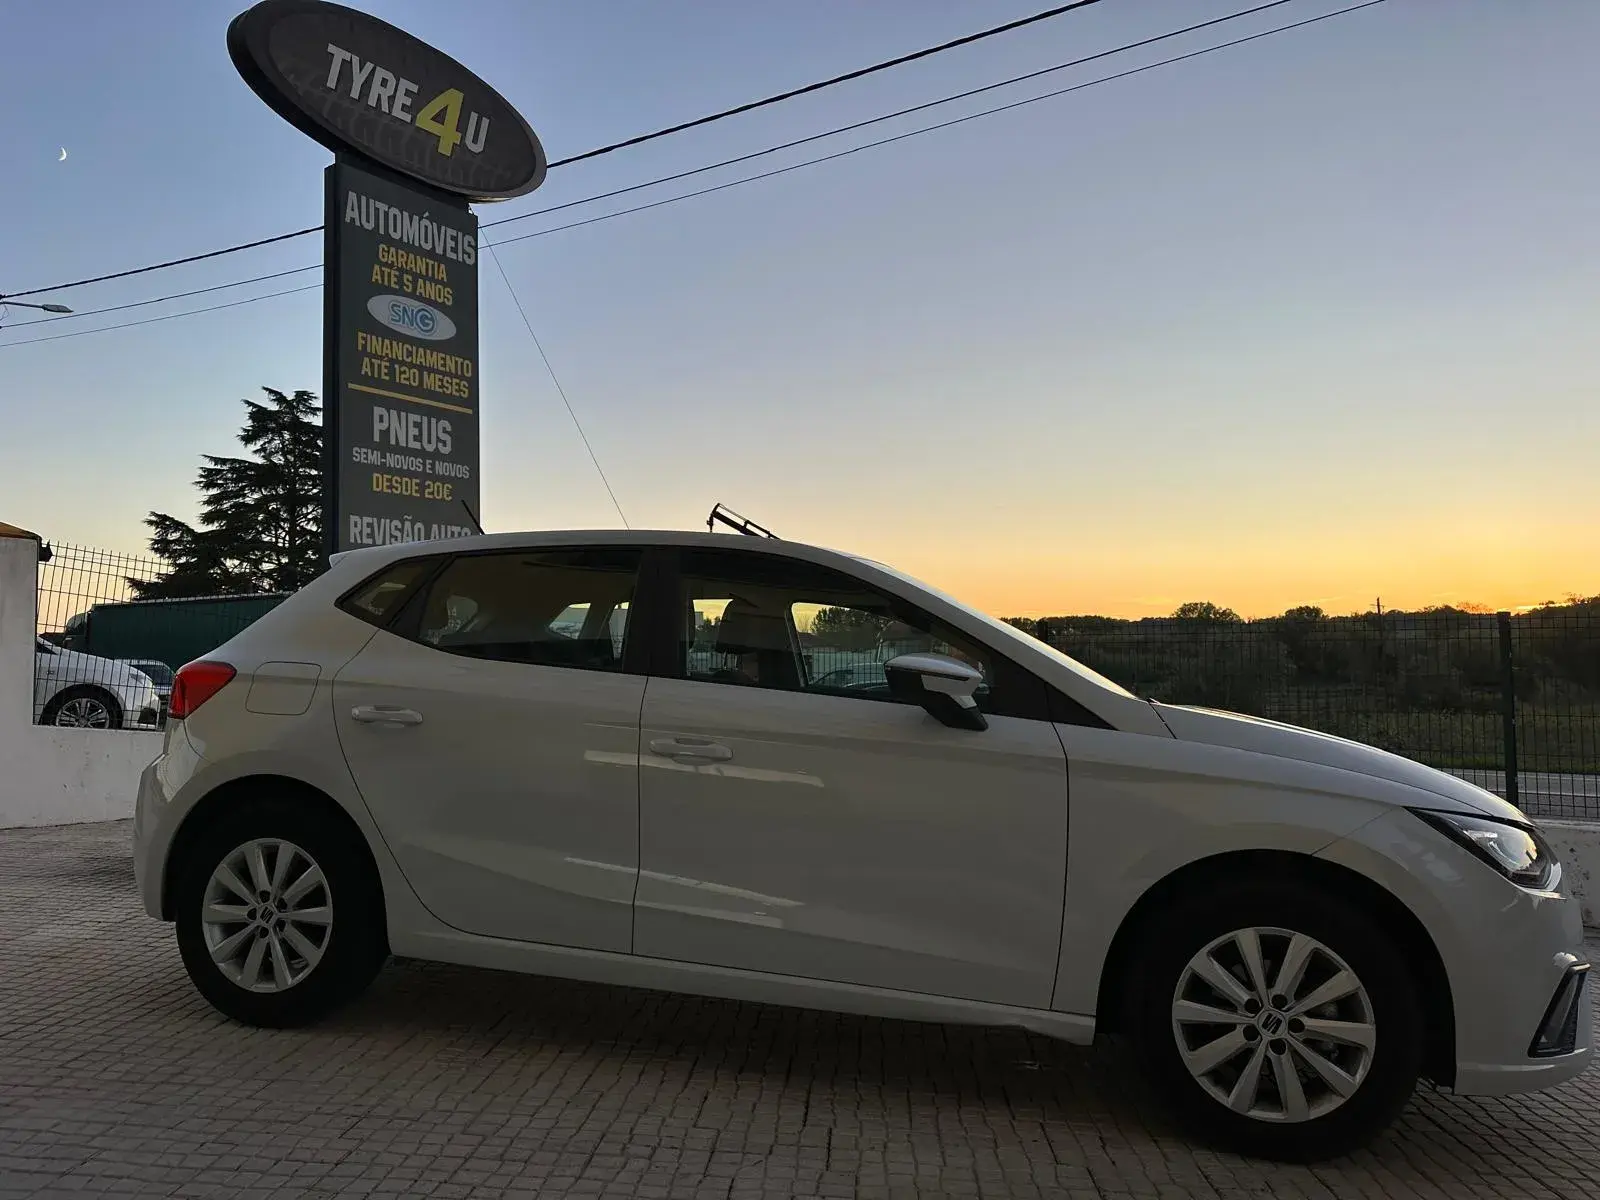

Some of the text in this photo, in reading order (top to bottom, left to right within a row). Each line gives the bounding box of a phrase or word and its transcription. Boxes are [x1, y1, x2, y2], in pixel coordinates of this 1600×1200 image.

[326, 43, 490, 157] TYRE4U
[345, 190, 476, 265] AUTOMÓVEIS
[378, 243, 447, 282] GARANTIA
[372, 263, 453, 306] ATÉ 5 ANOS
[357, 331, 472, 378] FINANCIAMENTO
[361, 356, 469, 399] ATÉ 120 MESES
[373, 406, 452, 455] PNEUS
[352, 446, 470, 479] SEMI-NOVOS E NOVOS
[372, 472, 453, 502] DESDE 20€
[349, 514, 425, 545] REVISÃO
